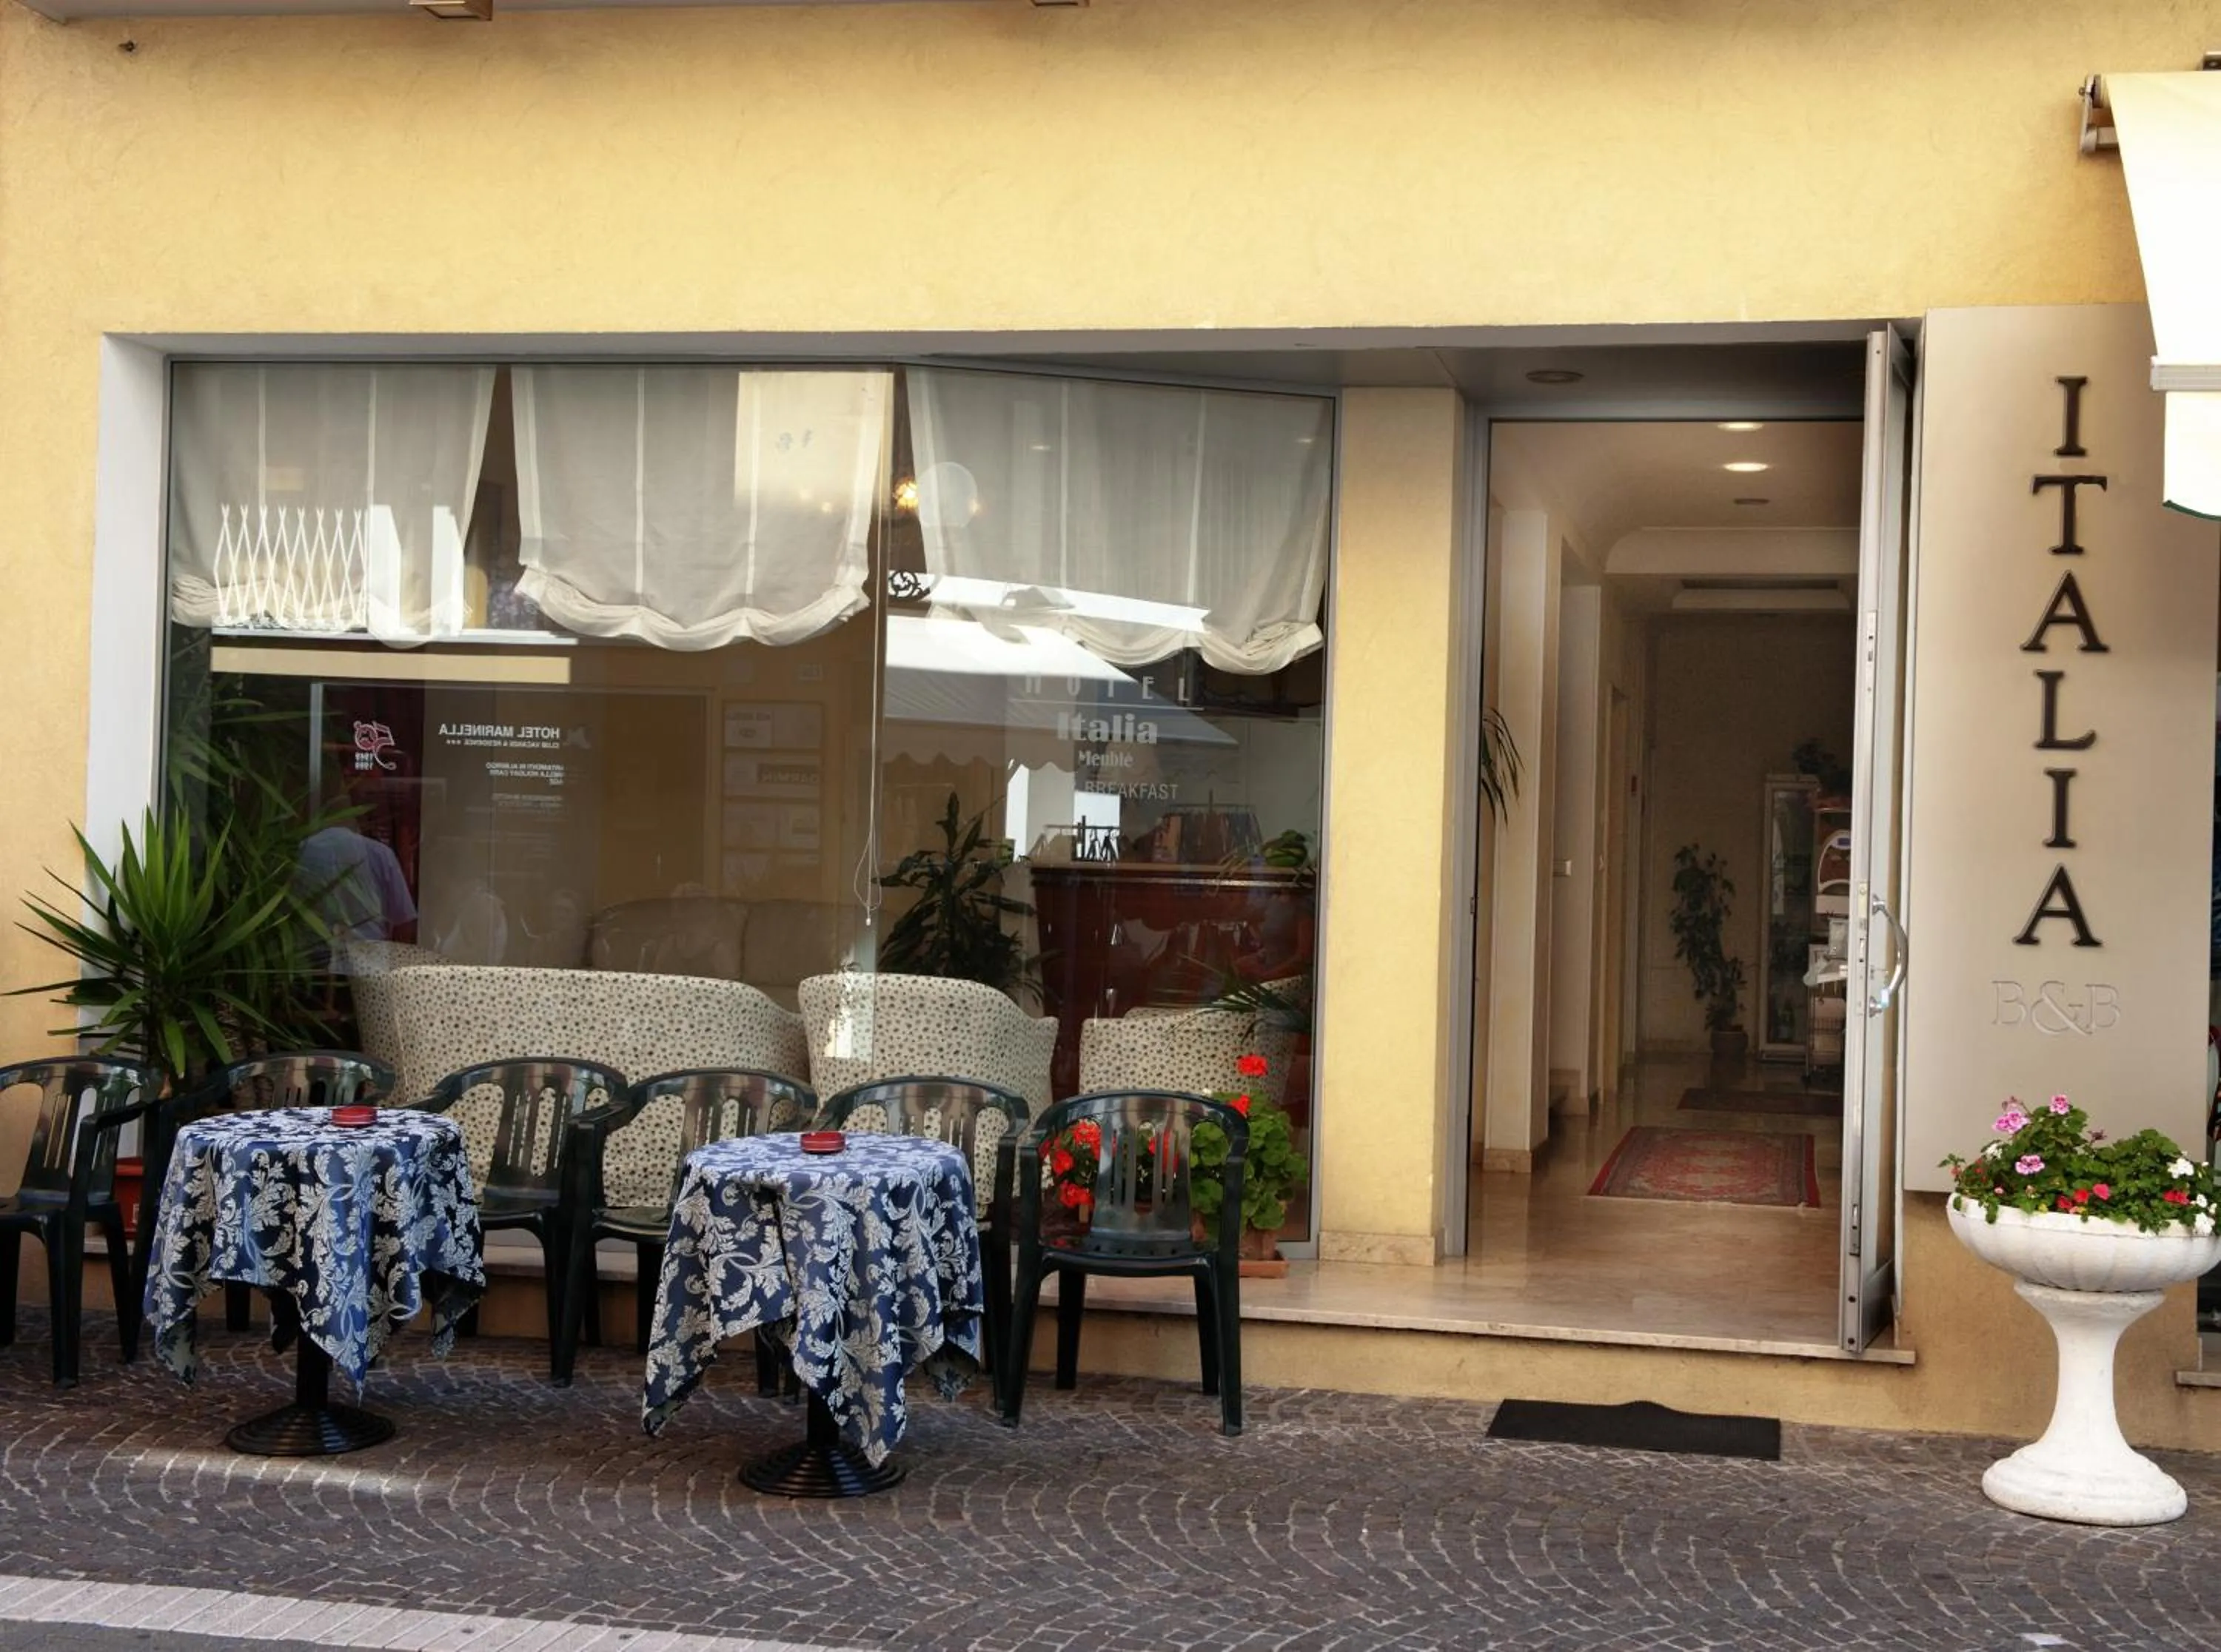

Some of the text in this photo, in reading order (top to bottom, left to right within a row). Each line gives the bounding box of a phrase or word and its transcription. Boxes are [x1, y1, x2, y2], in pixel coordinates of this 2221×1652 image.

[2012, 375, 2110, 947] ITALIA
[1057, 711, 1159, 745] Italia
[1084, 780, 1179, 800] BREAKFAST
[1990, 978, 2123, 1035] B&B
